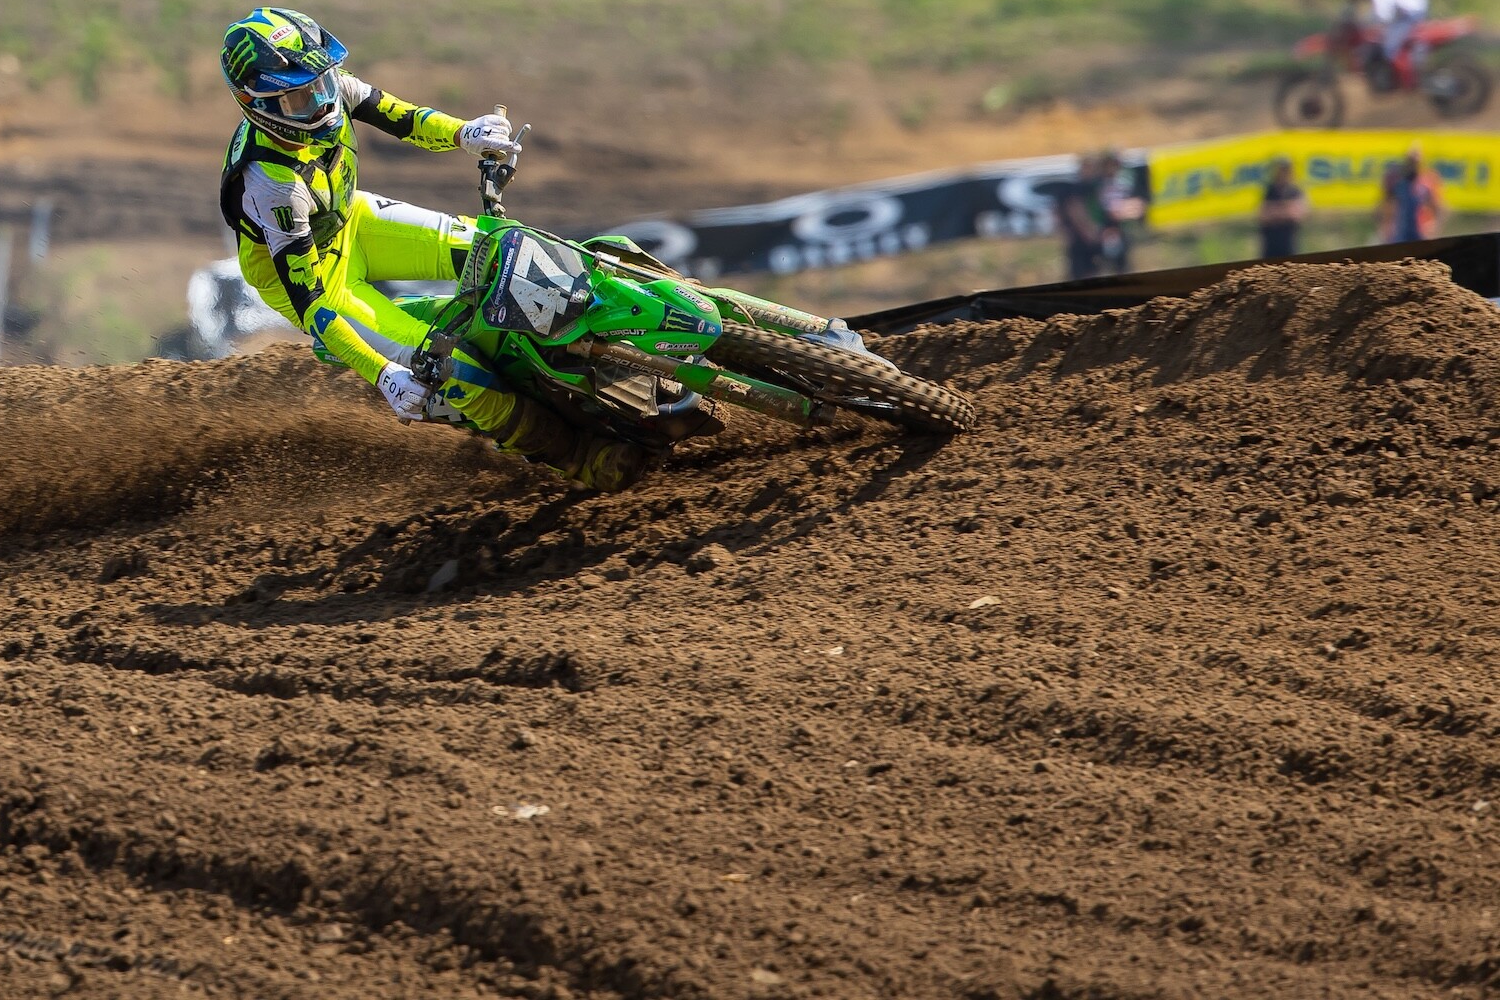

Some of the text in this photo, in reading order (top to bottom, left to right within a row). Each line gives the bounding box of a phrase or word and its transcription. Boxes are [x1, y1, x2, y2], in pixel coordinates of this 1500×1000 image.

[272, 26, 295, 41] BELL
[509, 235, 575, 336] 47
[610, 328, 647, 337] CIRCUIT
[600, 353, 629, 366] PRO
[382, 375, 405, 401] FOX
